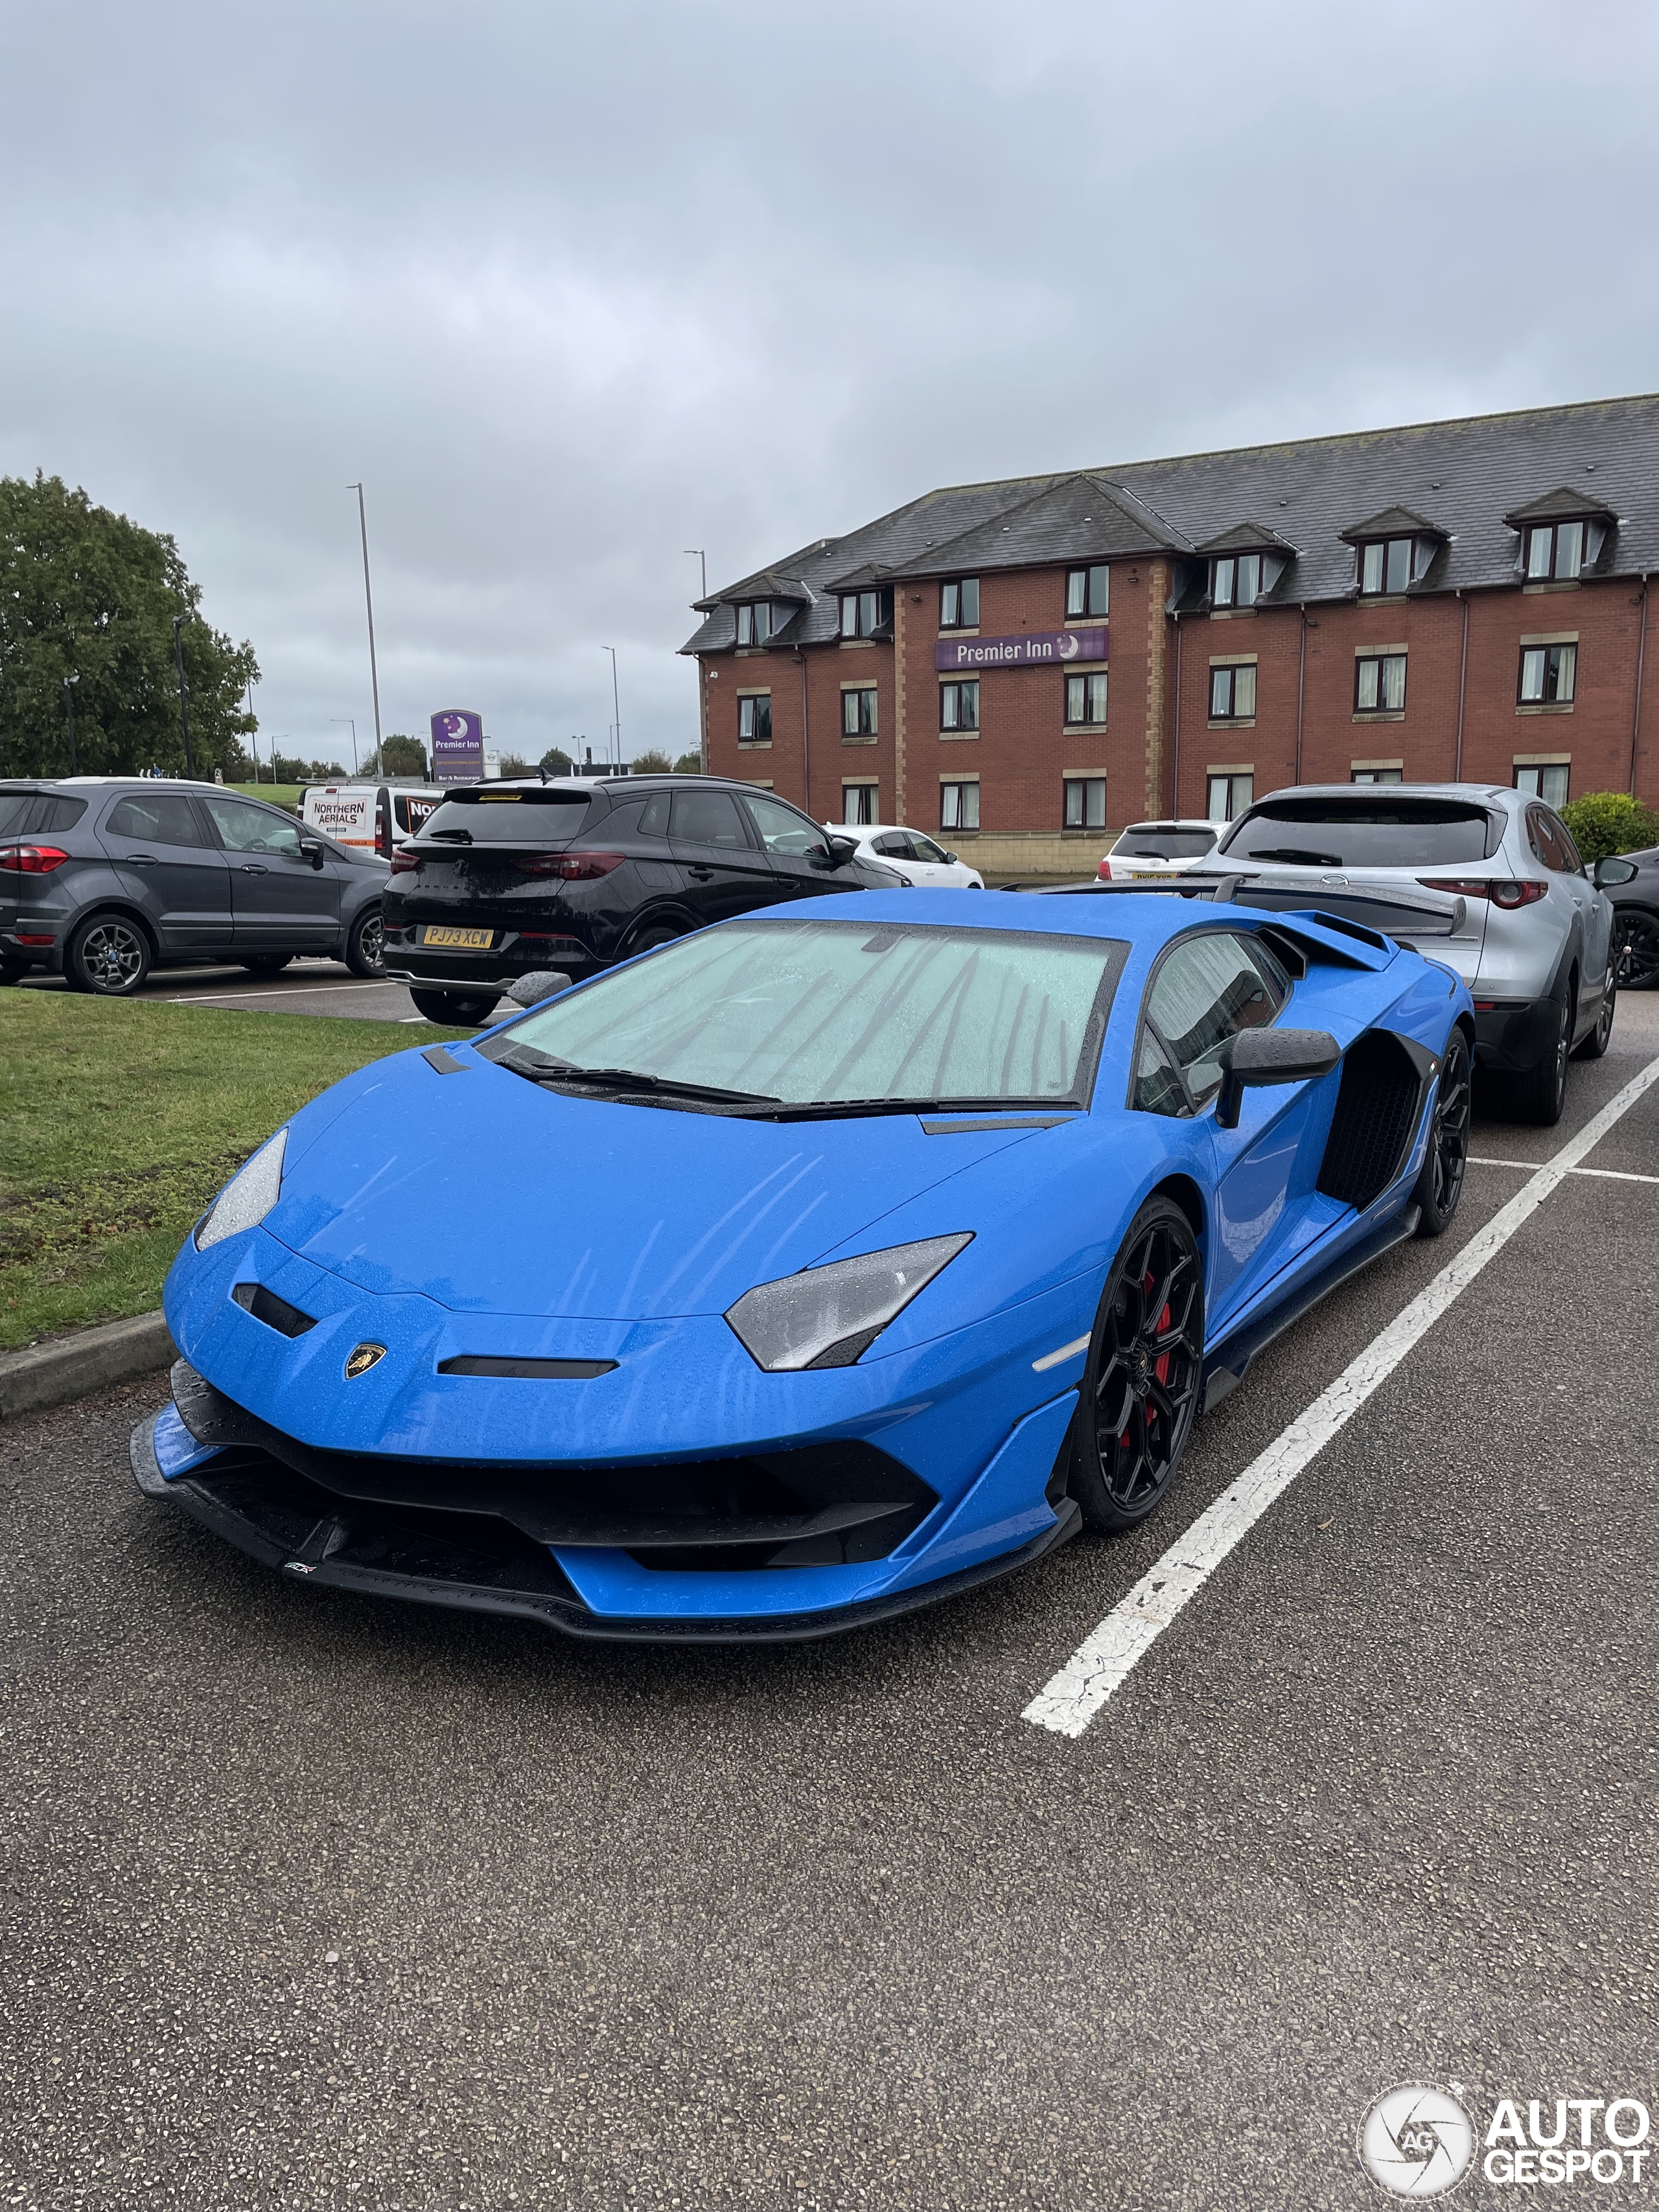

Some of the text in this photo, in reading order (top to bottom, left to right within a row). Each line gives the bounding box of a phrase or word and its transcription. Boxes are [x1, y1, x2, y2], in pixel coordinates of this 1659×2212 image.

[957, 640, 1052, 662] Premier Inn
[435, 740, 480, 749] Premier Inn
[314, 802, 364, 813] NORTHERN
[318, 814, 357, 824] AERIALS
[429, 927, 488, 945] PJ73 XCW
